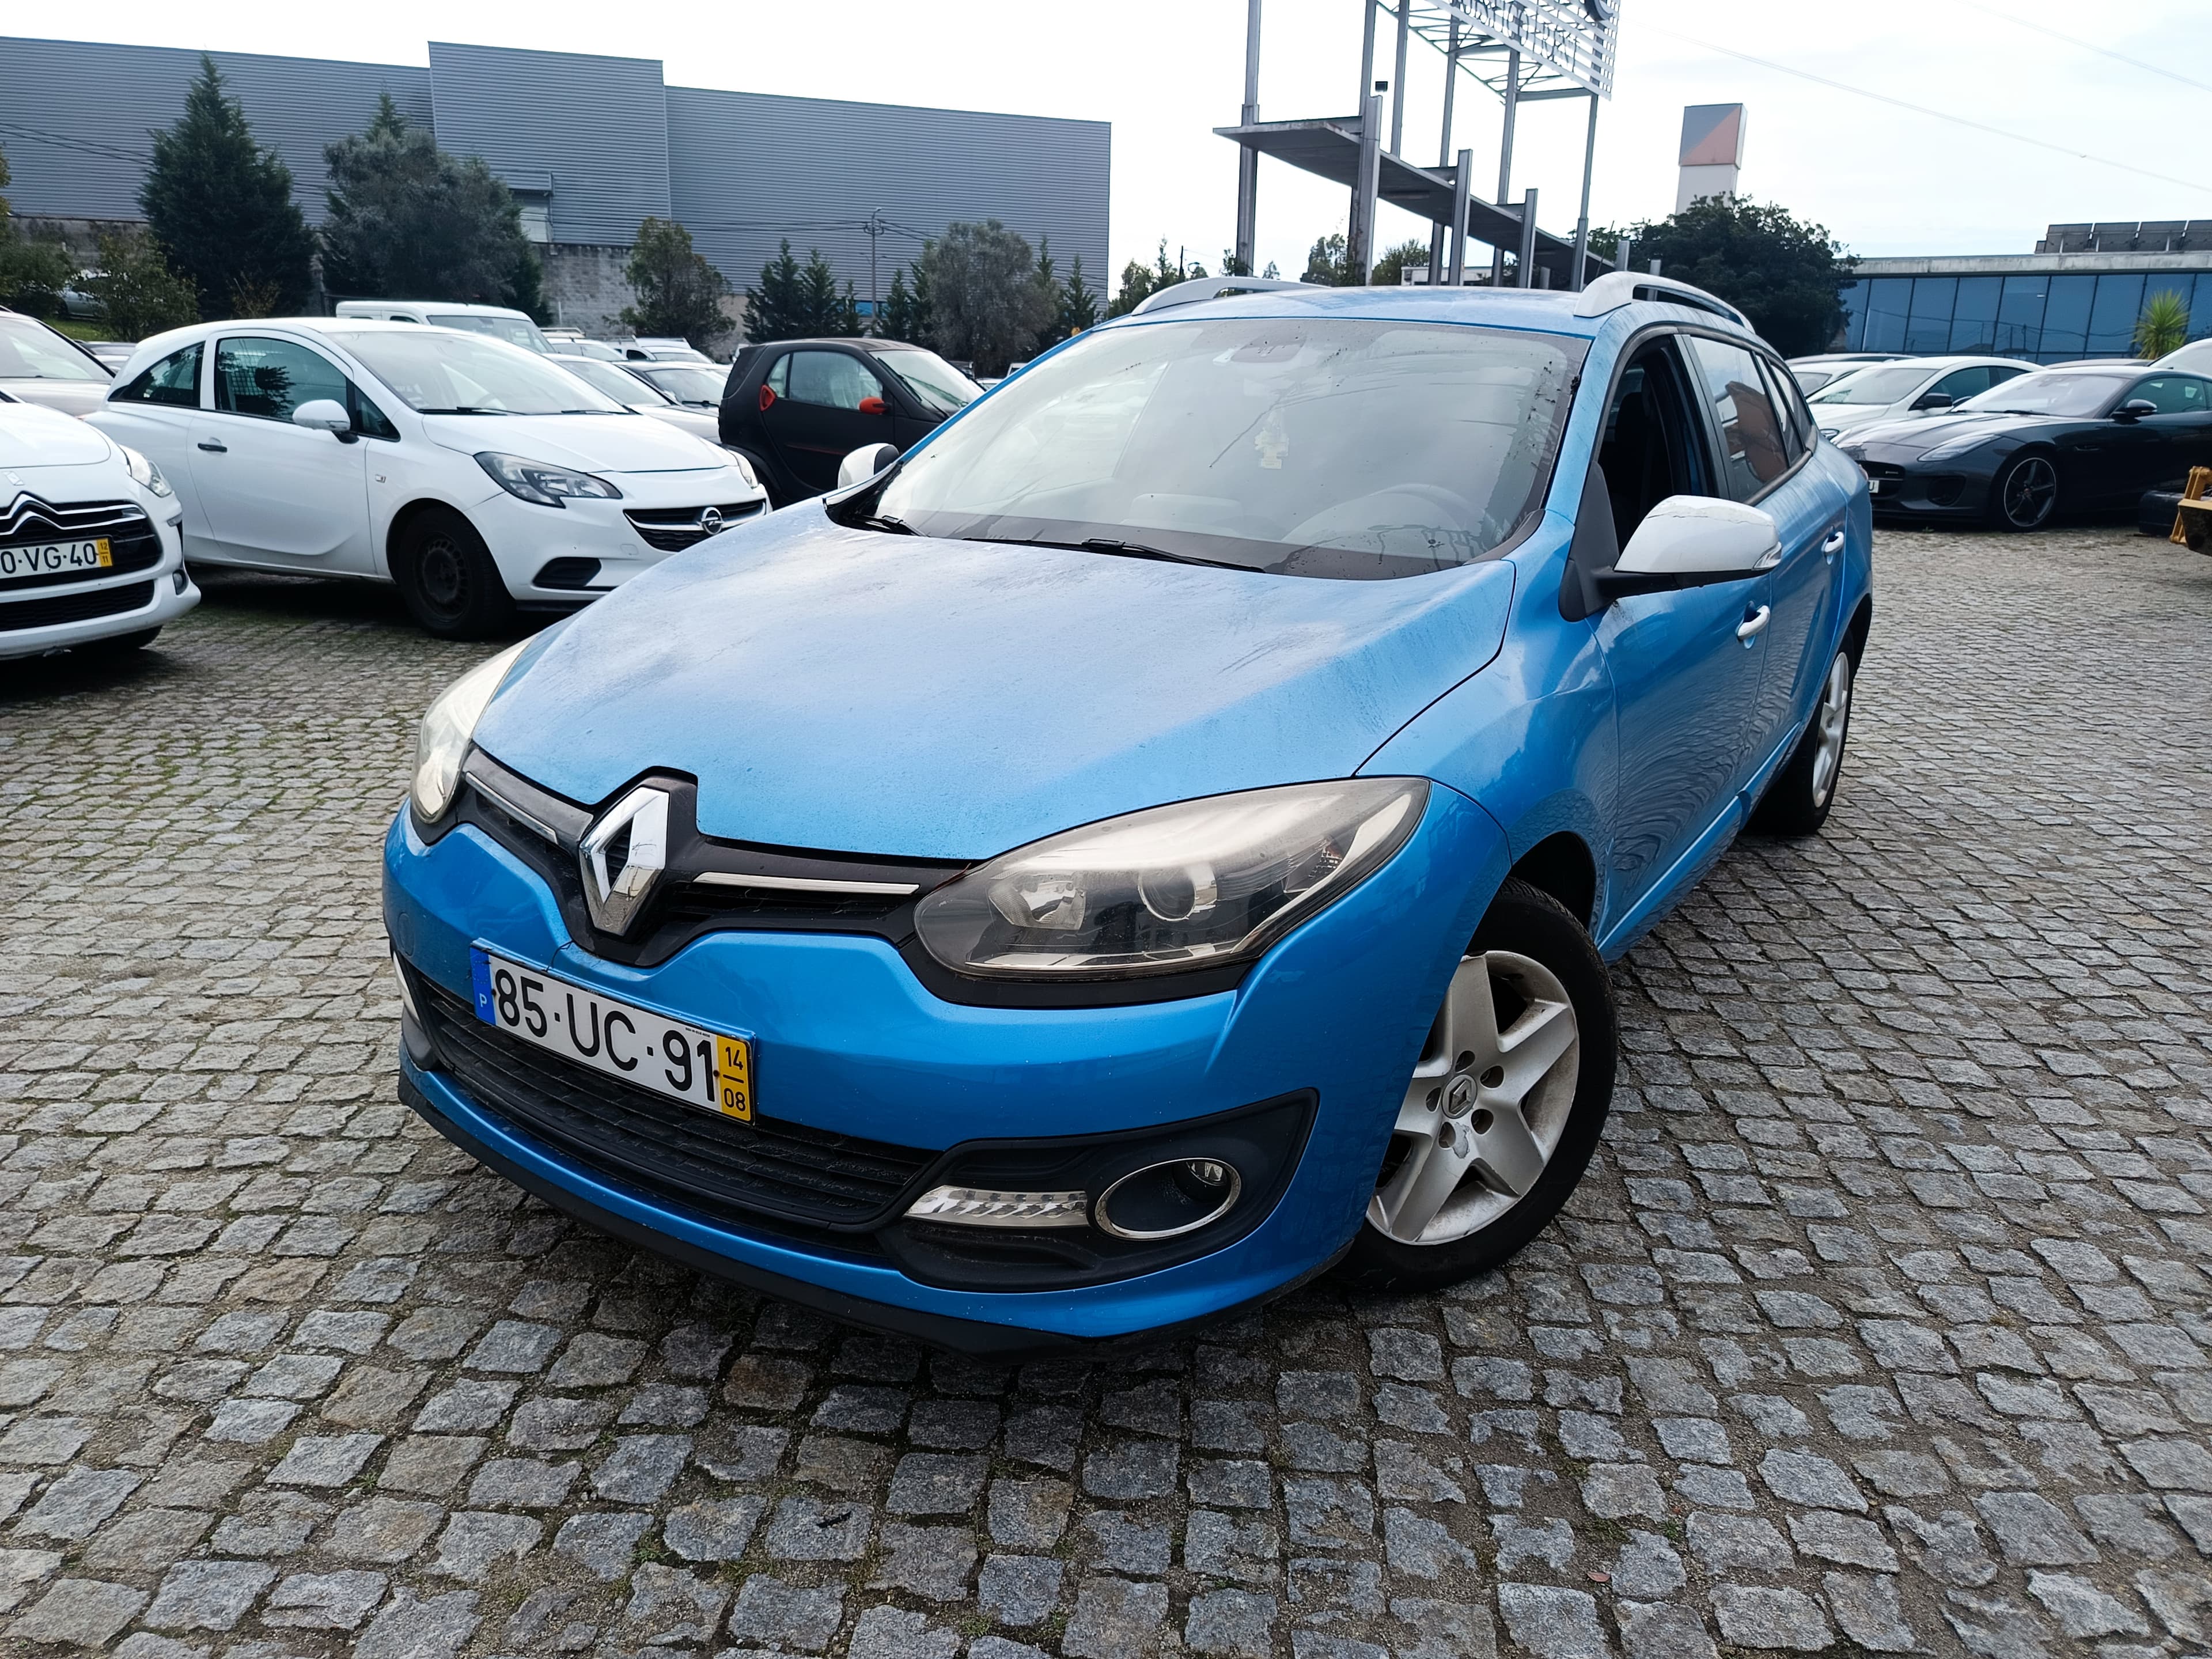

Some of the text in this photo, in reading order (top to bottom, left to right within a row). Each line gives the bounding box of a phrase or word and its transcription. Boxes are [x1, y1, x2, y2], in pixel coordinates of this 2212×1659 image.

[100, 541, 108, 551] 12
[479, 993, 487, 1008] P
[725, 1046, 744, 1070] 14
[724, 1088, 746, 1112] 08
